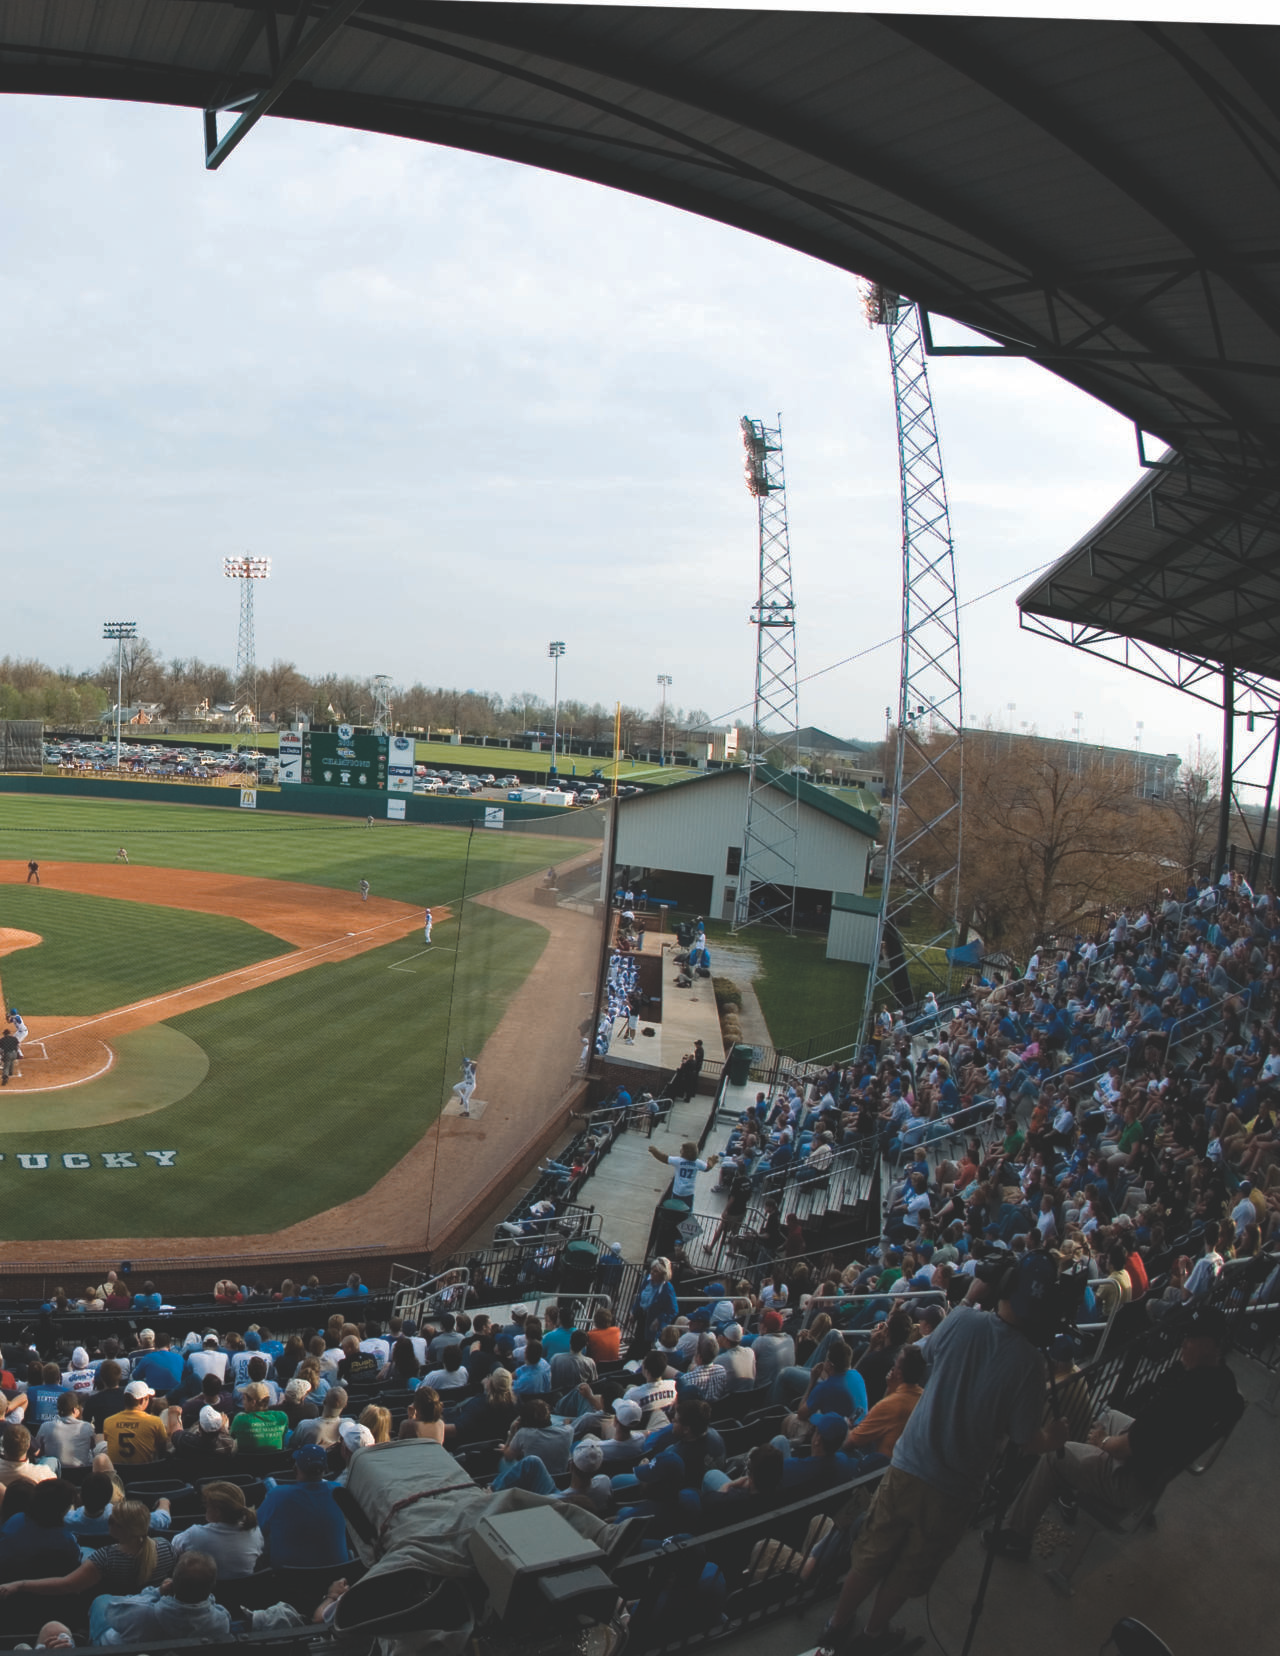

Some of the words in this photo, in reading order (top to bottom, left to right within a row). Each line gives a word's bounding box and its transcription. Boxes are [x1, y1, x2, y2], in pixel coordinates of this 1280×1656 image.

[322, 757, 371, 768] CHAMPIONS
[681, 1223, 698, 1232] EXIT
[639, 1390, 675, 1406] KENTUCKY
[118, 1432, 136, 1458] 5
